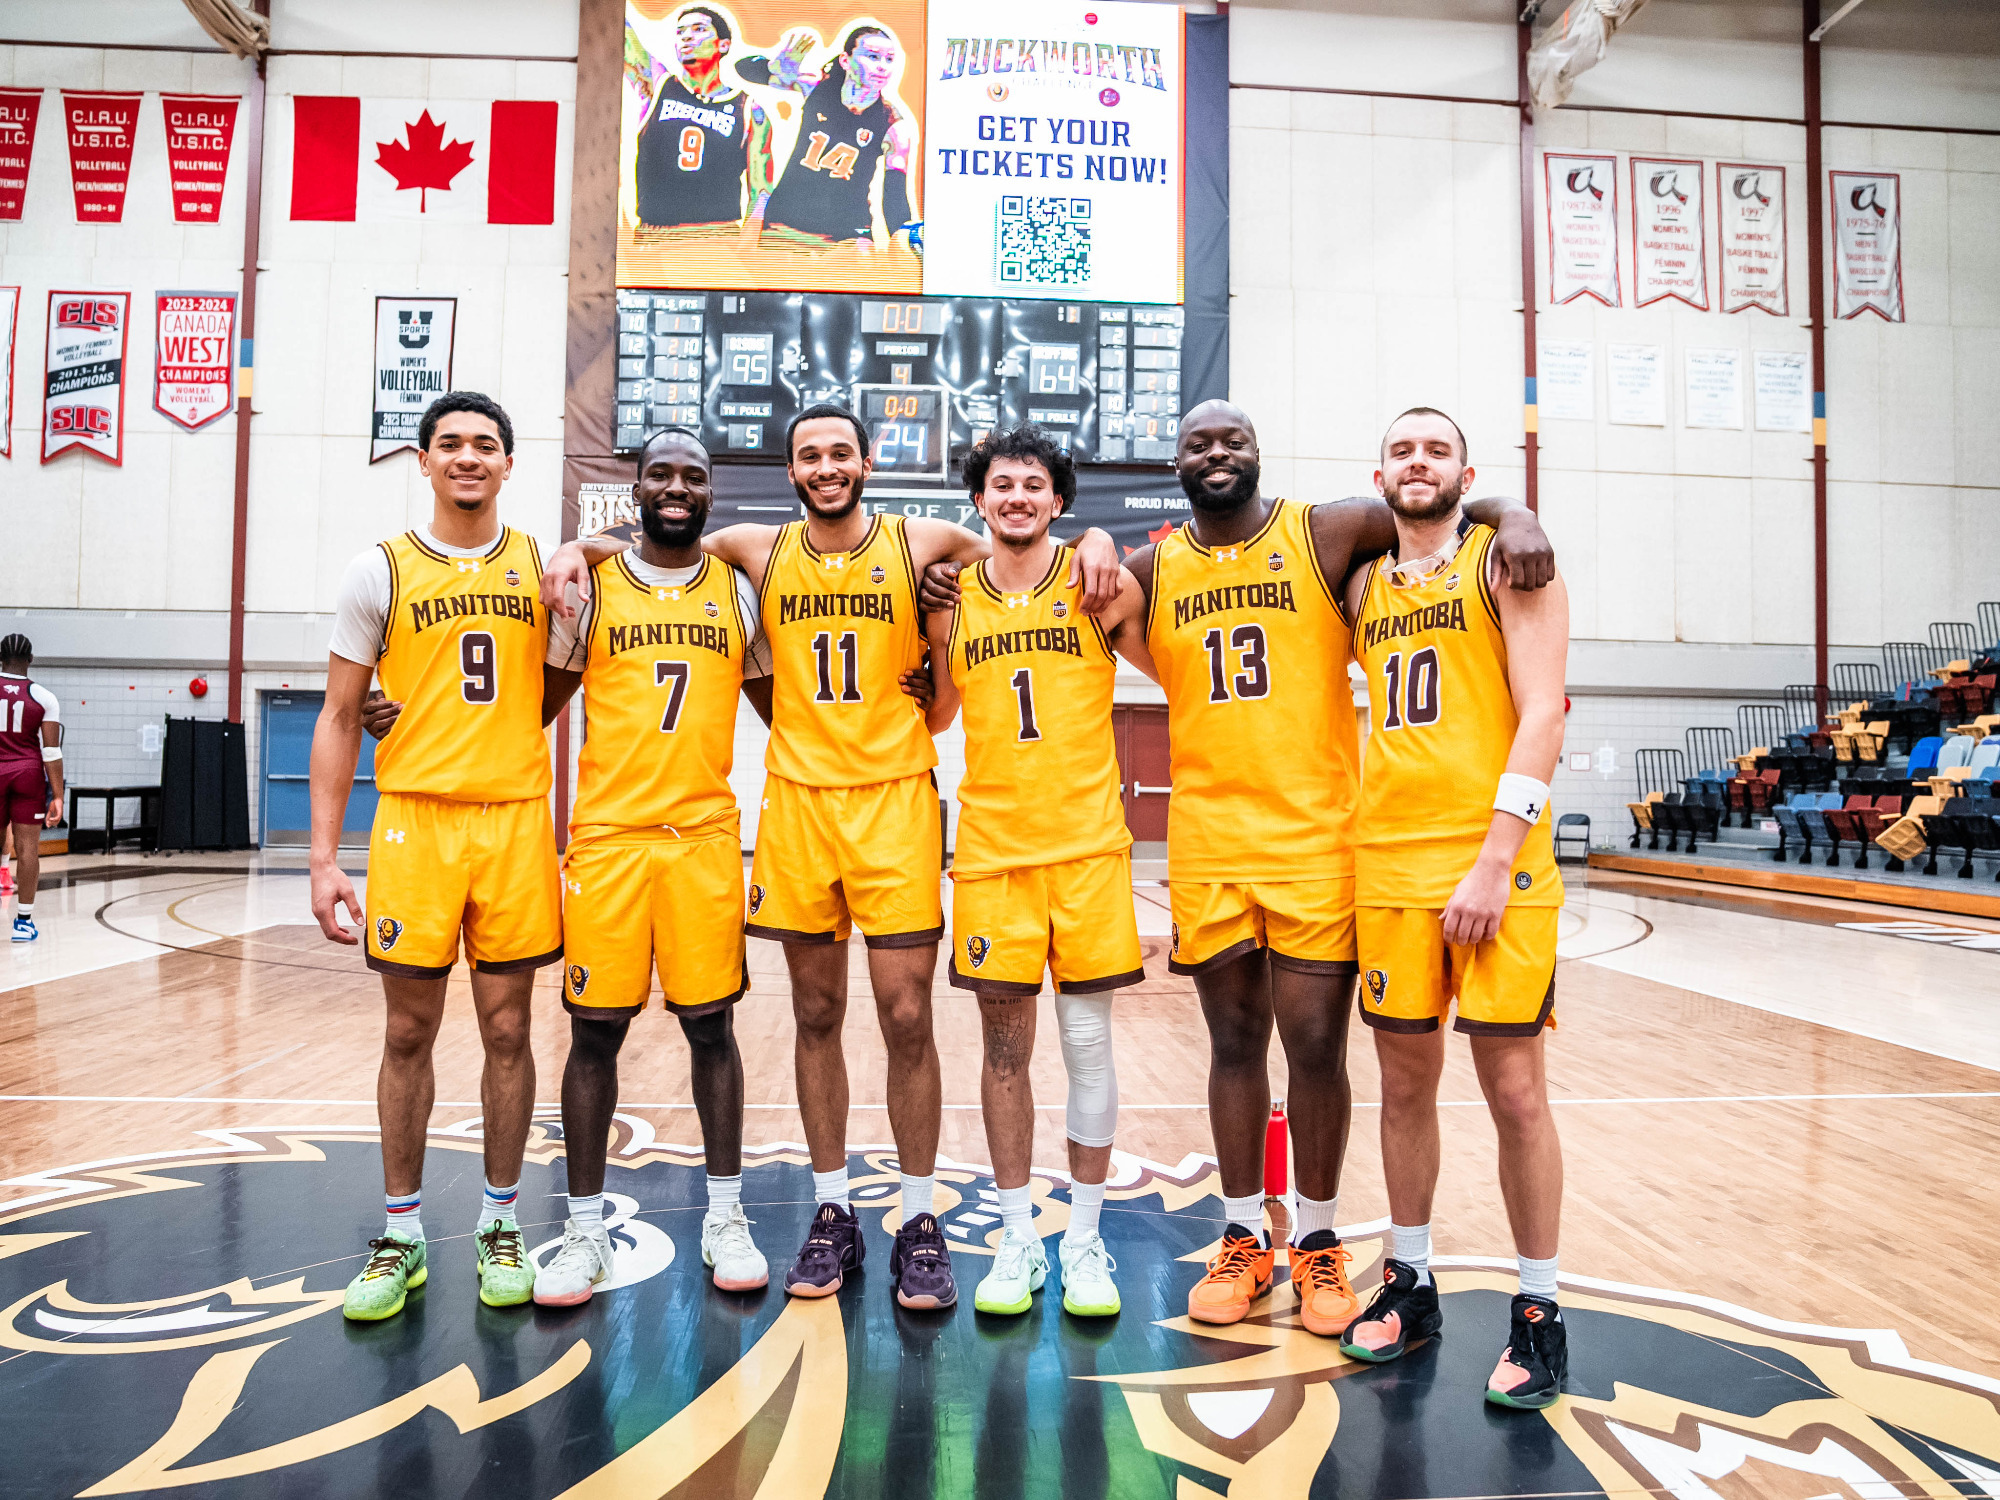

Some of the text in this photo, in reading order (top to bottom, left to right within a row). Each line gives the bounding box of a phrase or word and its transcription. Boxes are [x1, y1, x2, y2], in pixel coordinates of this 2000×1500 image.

[940, 38, 1167, 91] DUCKWORTH
[72, 110, 130, 125] C.I.A.U.
[171, 112, 228, 127] C.I.A.U.
[658, 98, 736, 137] BISONS
[72, 134, 130, 148] U.S.I.C.
[978, 115, 1130, 147] GET YOUR
[170, 136, 228, 150] U.S.I.C.
[678, 126, 705, 172] 9
[800, 130, 860, 180] 14
[75, 160, 126, 172] VOLLEYBALL
[173, 160, 224, 171] VOLLEYBALL
[938, 148, 1167, 184] TICKETS NOW!
[1656, 204, 1681, 214] 1996
[1741, 207, 1766, 216] 1997
[1652, 224, 1688, 234] WOMEN'S
[1846, 218, 1886, 228] 1975-76
[1644, 241, 1695, 252] BASKETBALL
[1735, 232, 1771, 242] WOMEN'S
[1726, 248, 1778, 259] BASKETBALL
[1648, 278, 1694, 286] CHAMPIONS
[1730, 289, 1777, 298] CHAMPIONS
[57, 300, 119, 325] CIS
[165, 298, 228, 311] 2023-2024
[164, 314, 228, 334] CANADA
[691, 316, 700, 331] 7
[1113, 328, 1123, 344] 2
[1167, 330, 1178, 346] 5
[64, 348, 102, 362] VOLLEYBALL
[164, 336, 226, 364] WEST
[58, 364, 107, 380] 2013-14
[400, 357, 426, 368] WOMEN'S
[632, 360, 643, 375] 4
[733, 354, 768, 384] 95
[50, 372, 115, 394] CHAMPIONS
[160, 370, 226, 382] CHAMPIONS
[380, 370, 442, 392] VOLLEYBALL
[1039, 364, 1076, 392] 64
[170, 395, 215, 404] VOLLEYBALL
[176, 386, 211, 394] WOMEN'S
[1167, 397, 1177, 414] 5
[50, 405, 112, 432] SIC
[746, 425, 758, 449] 5
[876, 424, 926, 463] 24
[1124, 497, 1162, 509] PROUD
[410, 594, 535, 634] MANITOBA
[780, 593, 895, 626] MANITOBA
[1173, 580, 1298, 630] MANITOBA
[1364, 598, 1468, 652] MANITOBA
[608, 624, 730, 658] MANITOBA
[964, 626, 1084, 672] MANITOBA
[459, 630, 498, 704] 9
[811, 631, 864, 704] 11
[1202, 622, 1271, 704] 13
[654, 660, 690, 734] 7
[1383, 646, 1442, 732] 10
[1010, 668, 1042, 742] 1
